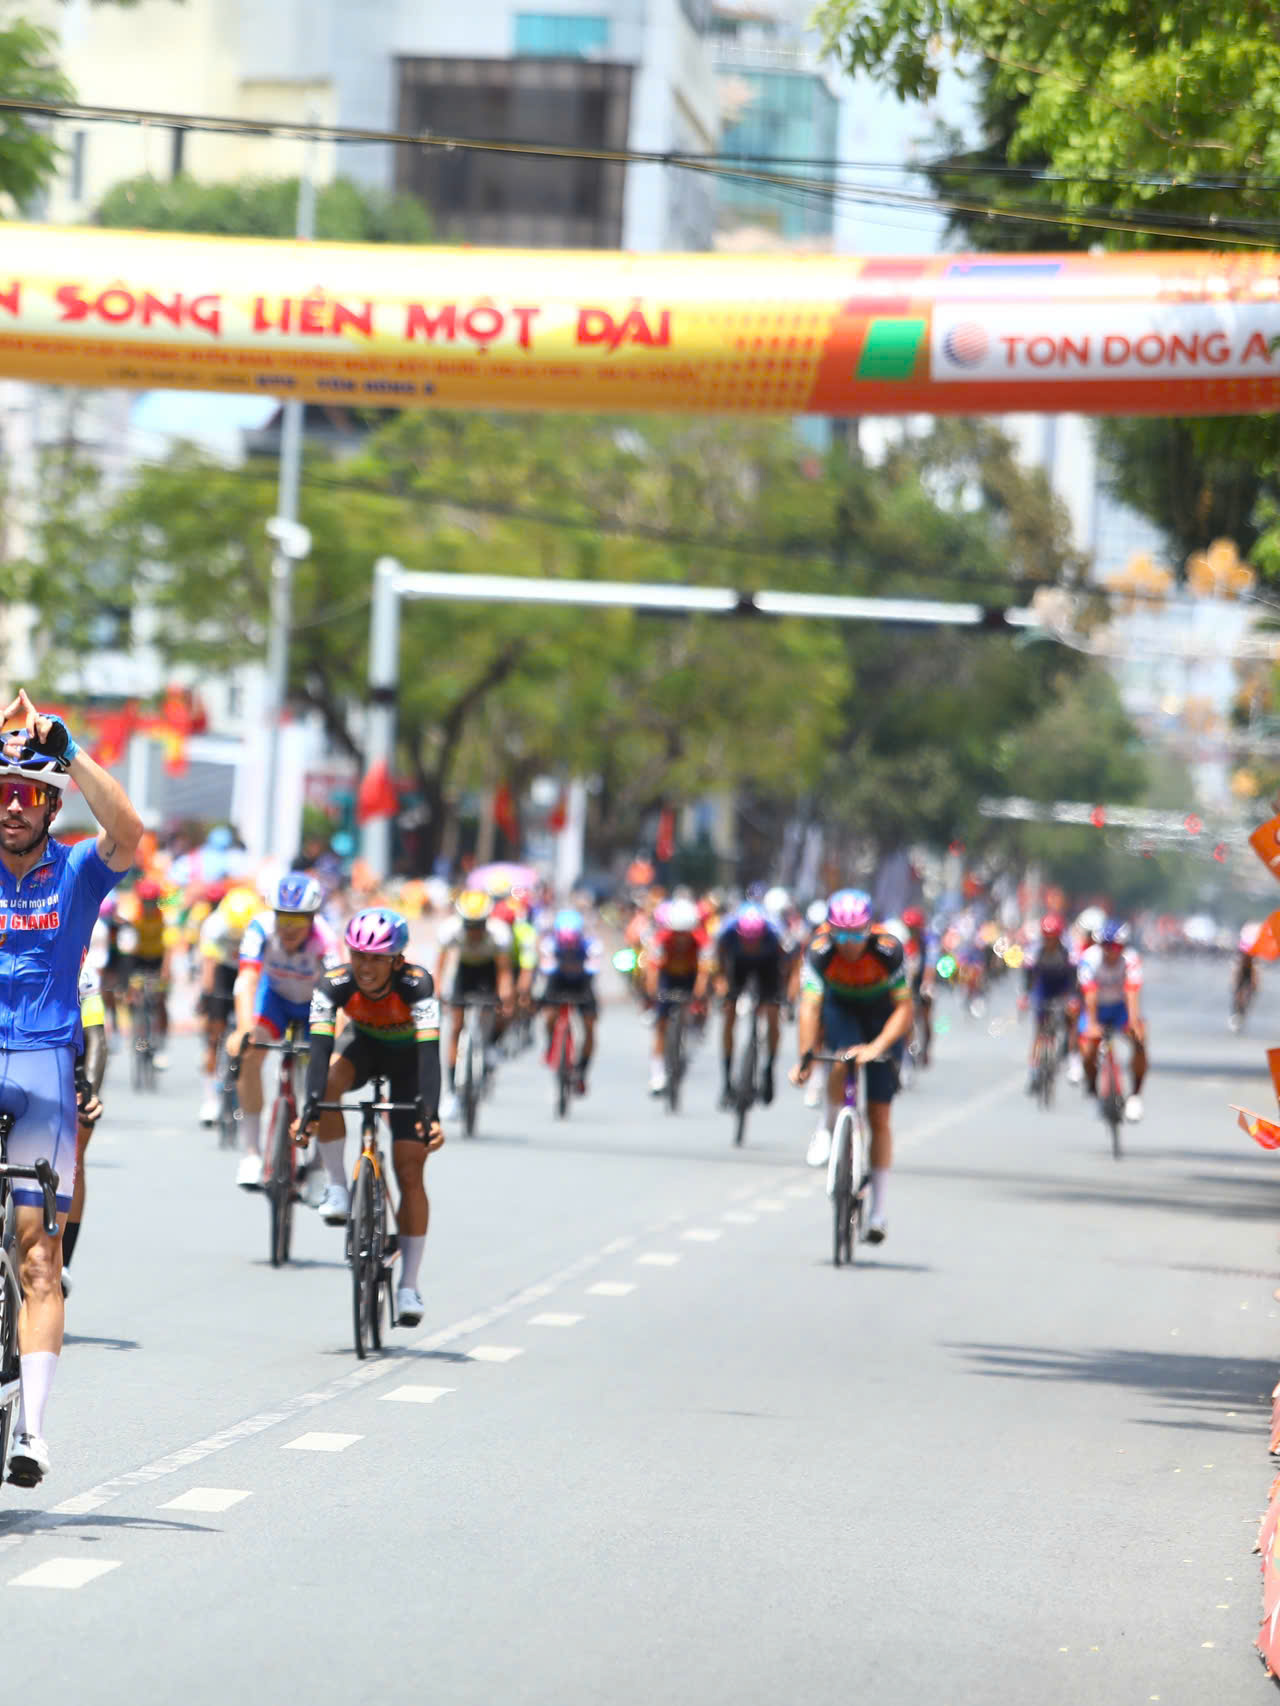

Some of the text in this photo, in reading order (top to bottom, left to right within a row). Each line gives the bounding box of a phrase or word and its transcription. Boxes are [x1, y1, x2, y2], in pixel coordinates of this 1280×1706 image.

[55, 279, 222, 338] SÔNG
[1000, 333, 1274, 367] TON DONG A
[10, 911, 60, 931] GIANG
